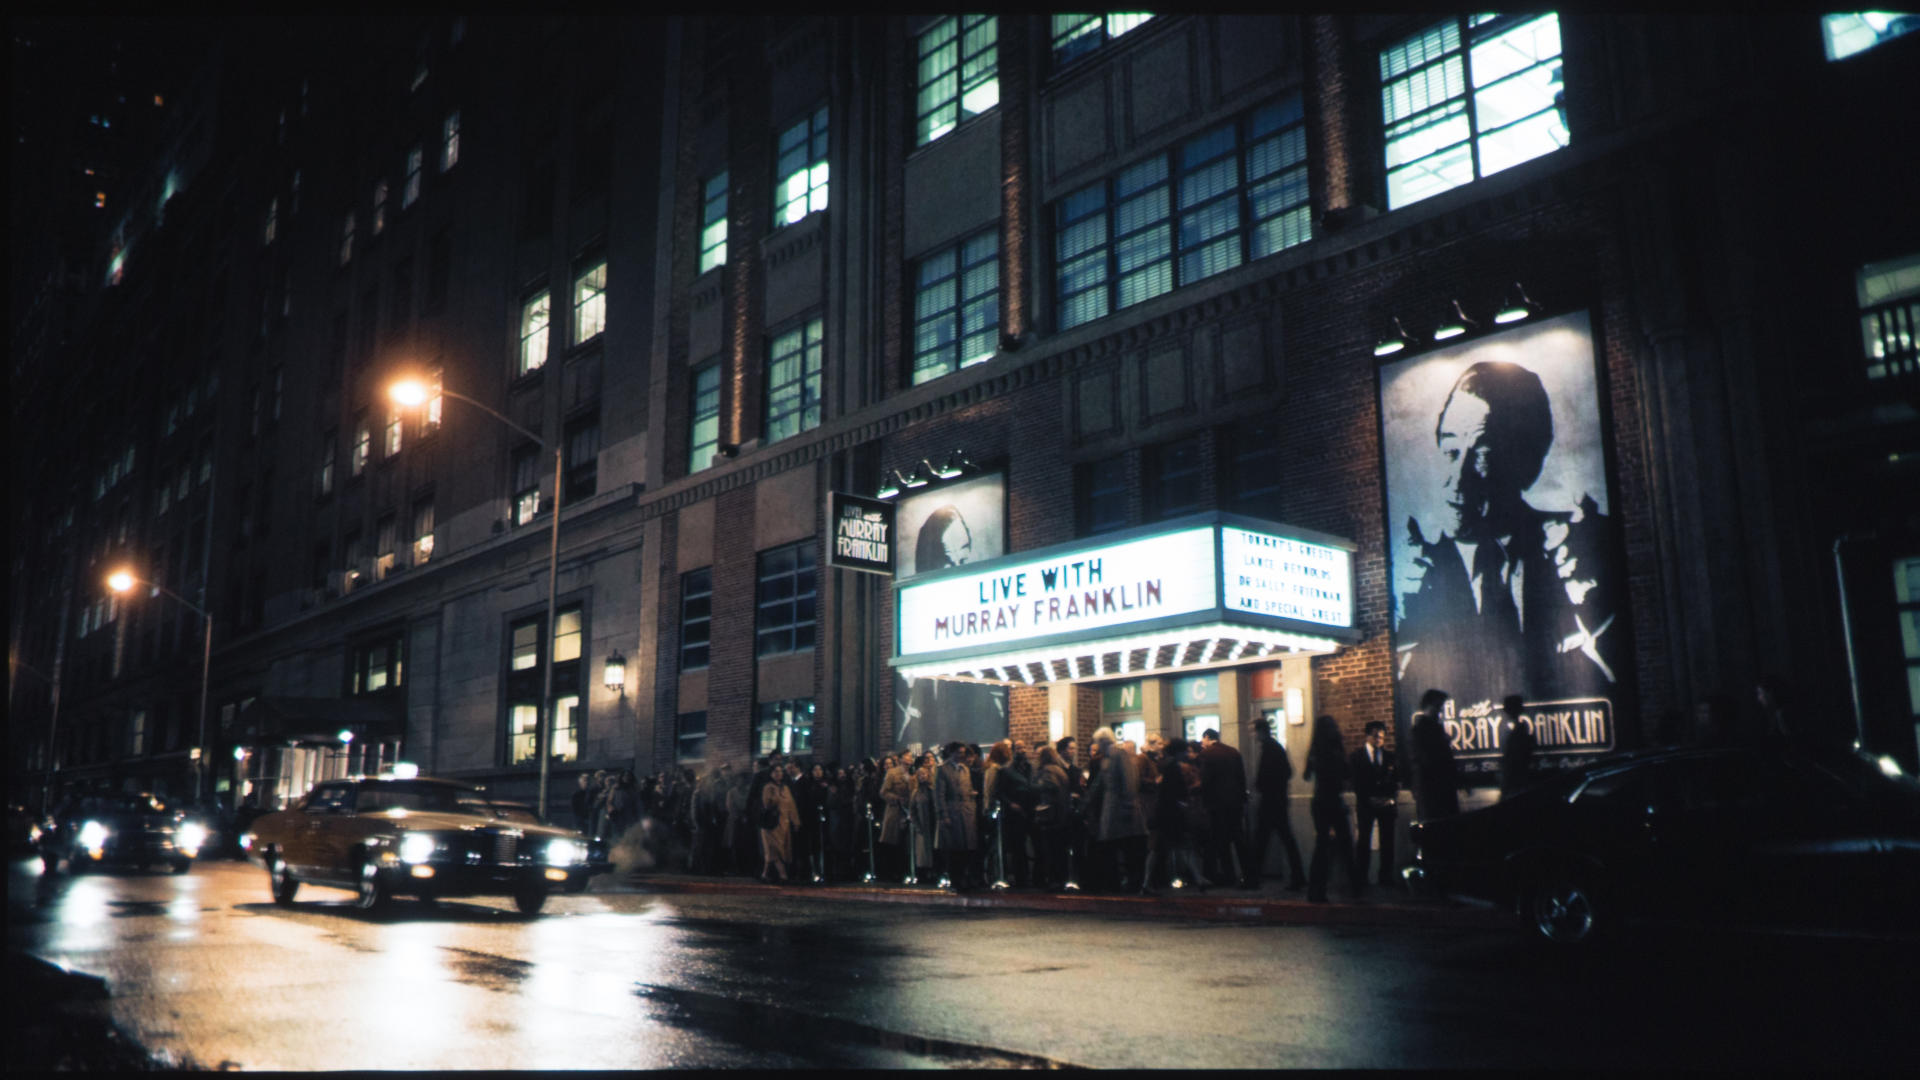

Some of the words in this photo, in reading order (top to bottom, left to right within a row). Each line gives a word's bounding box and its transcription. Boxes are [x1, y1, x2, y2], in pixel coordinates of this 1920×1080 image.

[838, 518, 888, 542] MURRAY
[837, 536, 888, 563] FRANKLIN
[1300, 544, 1334, 561] GUESTS
[979, 573, 1027, 604] LIVE
[1041, 558, 1102, 592] WITH
[934, 603, 1020, 640] MURRAY
[1033, 578, 1163, 625] FRANKLIN
[1240, 597, 1260, 609] AND
[1265, 601, 1305, 617] SPECIAL
[1312, 609, 1342, 623] GUEST
[1120, 685, 1135, 708] N
[1192, 679, 1207, 701] C
[1459, 700, 1493, 718] with
[1443, 715, 1503, 751] RRAY
[1507, 709, 1606, 747] ANKLIN
